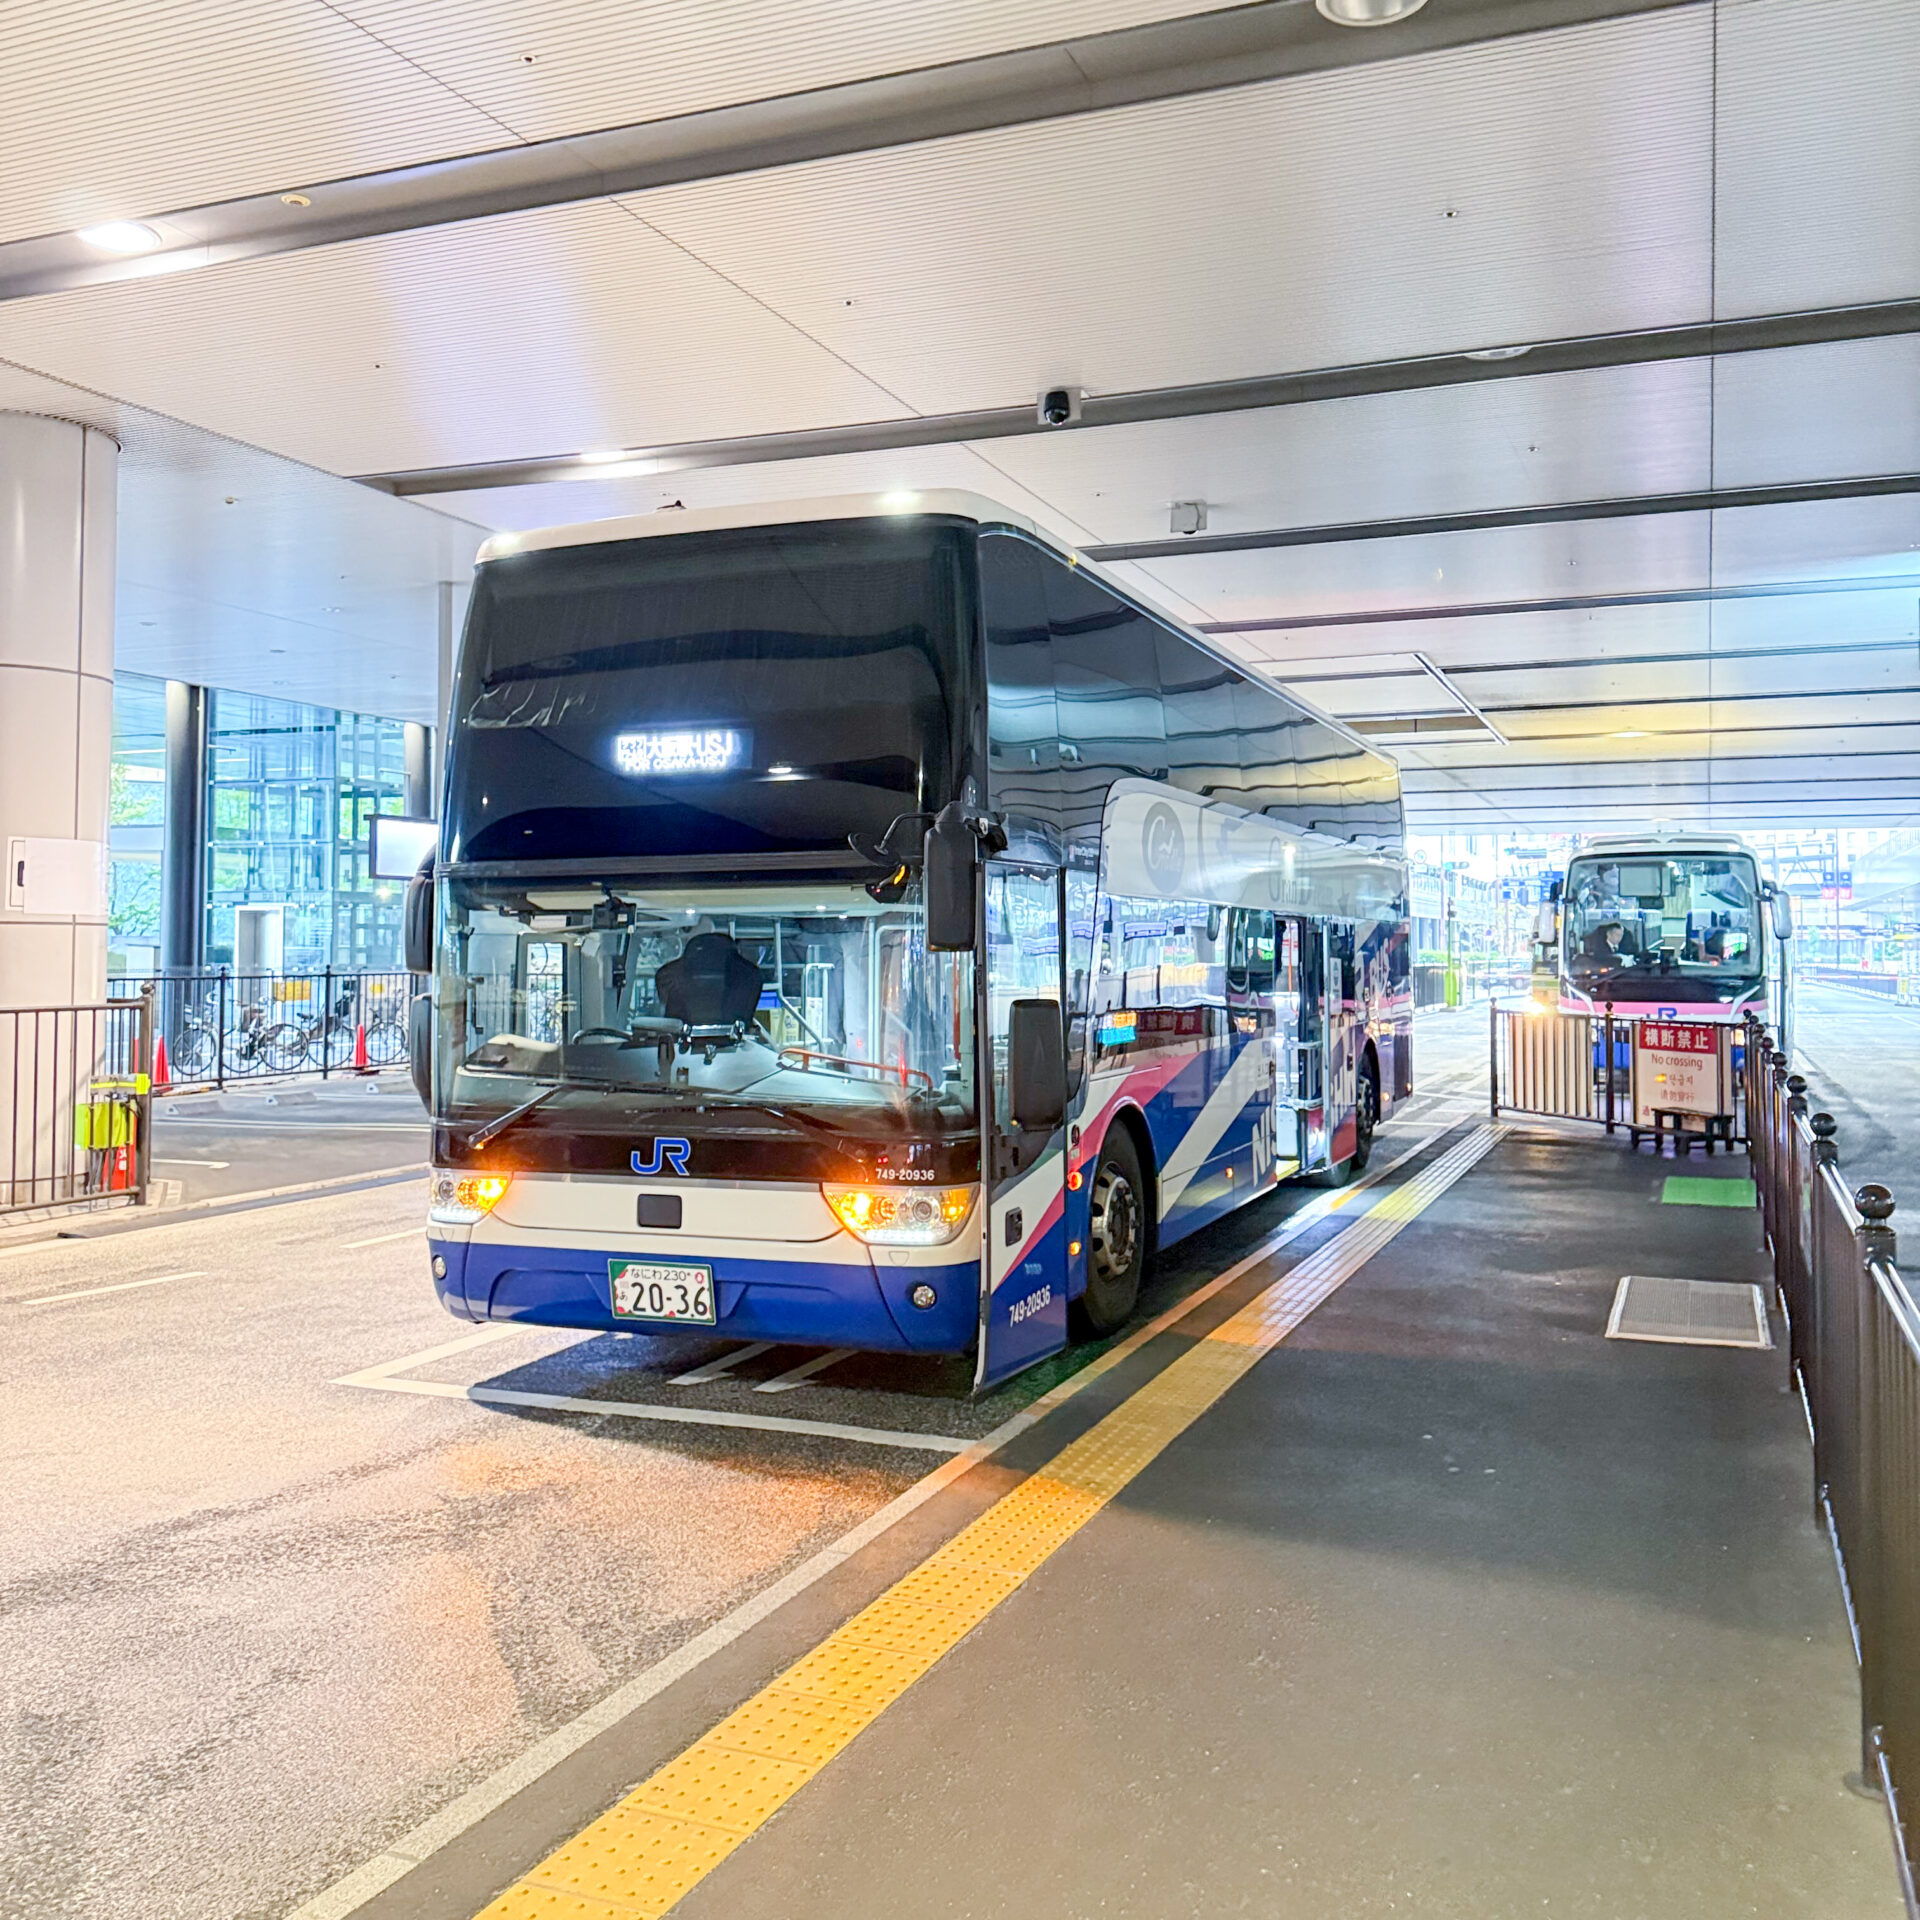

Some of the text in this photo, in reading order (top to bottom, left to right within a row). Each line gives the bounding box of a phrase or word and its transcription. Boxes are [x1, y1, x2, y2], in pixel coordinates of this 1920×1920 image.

[1645, 1027, 1709, 1050] 横断禁止
[1651, 1053, 1703, 1071] No crossing
[630, 1136, 691, 1176] JR
[875, 1168, 935, 1181] 749-20936
[631, 1282, 708, 1316] 20-36
[1009, 1284, 1051, 1328] 749-20936
